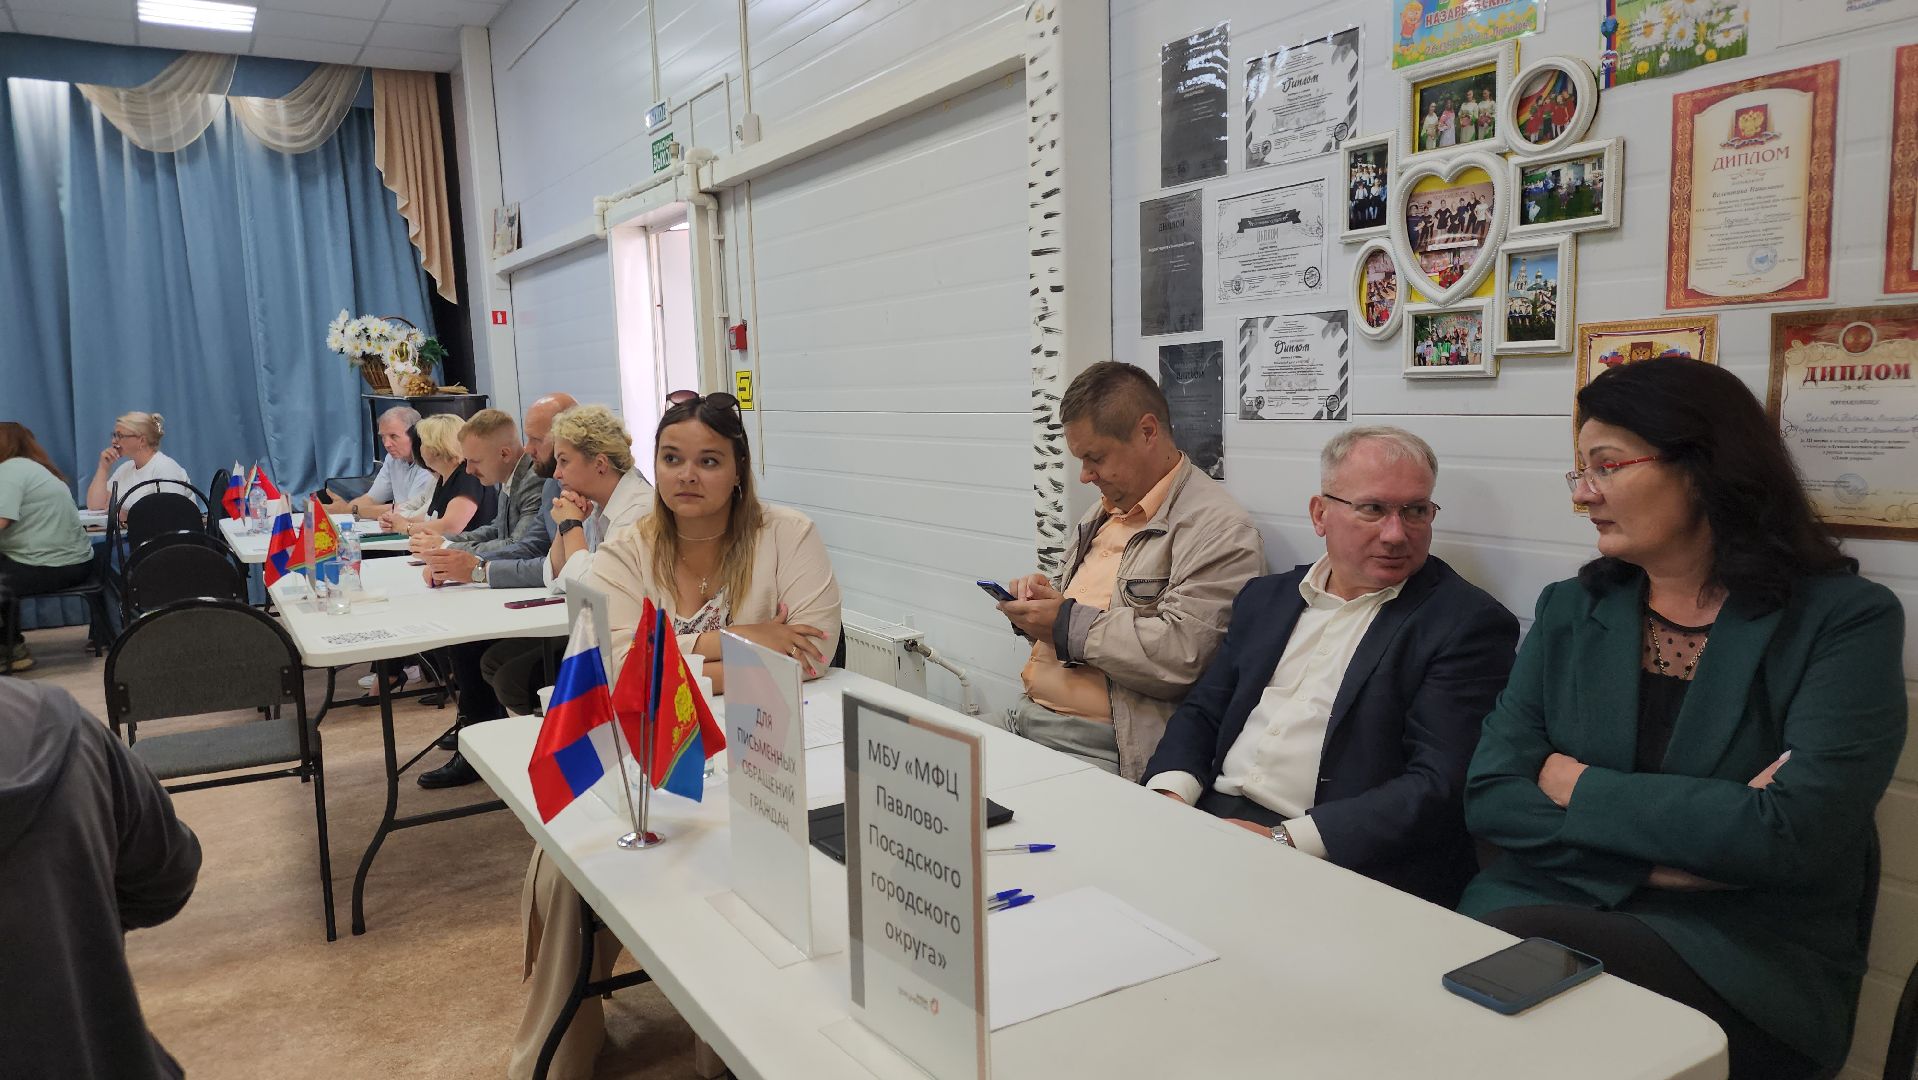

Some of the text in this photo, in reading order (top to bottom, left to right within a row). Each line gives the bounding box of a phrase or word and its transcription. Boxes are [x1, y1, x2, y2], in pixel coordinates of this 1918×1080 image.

[1711, 146, 1790, 172] ДИПЛОМ
[1274, 340, 1310, 355] Диплом
[1803, 363, 1912, 387] ДИПЛОМ
[756, 708, 773, 732] ДЛЯ
[737, 726, 797, 776] ПИСЬМЕННЫХ
[868, 739, 959, 801] МБУ «МФЦ
[742, 759, 795, 805] ОБРАЩЕНИЙ
[750, 792, 790, 833] ГРАЖДАН
[876, 785, 950, 835] Павлово-
[868, 823, 962, 889] Посадского
[871, 870, 962, 935] городского
[885, 921, 948, 970] округа»
